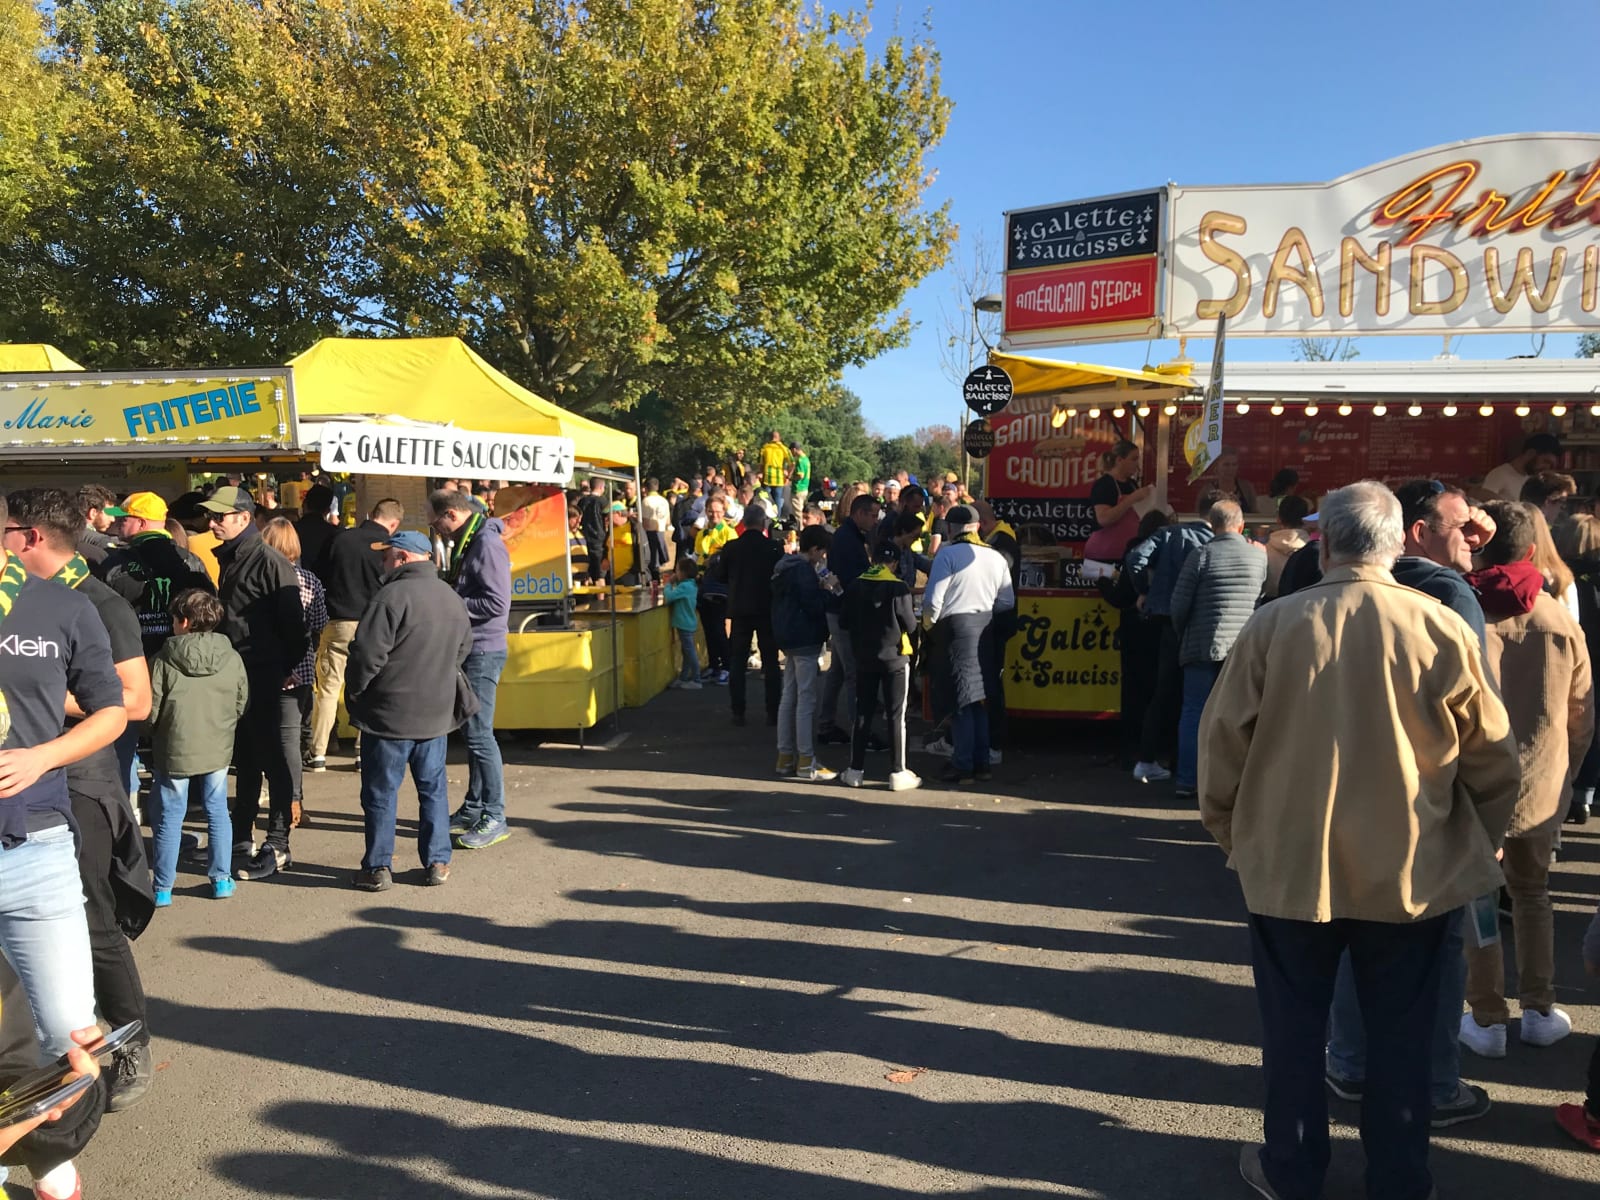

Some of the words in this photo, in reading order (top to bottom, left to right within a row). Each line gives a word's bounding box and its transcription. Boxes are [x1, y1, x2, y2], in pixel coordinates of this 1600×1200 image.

[1031, 208, 1135, 240] Galette
[1030, 232, 1134, 259] Saucisse
[1196, 211, 1598, 320] SANDWI
[1016, 283, 1086, 313] AMÉRICAIN
[965, 392, 1010, 401] SAUCISSE
[966, 382, 1010, 392] GALETTE
[4, 396, 96, 430] Marie
[123, 382, 261, 438] FRITERIE
[357, 435, 444, 466] GALETTE
[451, 440, 543, 471] SAUCISSE
[512, 573, 563, 594] ebab
[0, 634, 59, 659] Klein
[1016, 615, 1121, 660] Galett
[1032, 660, 1119, 687] Sauciss
